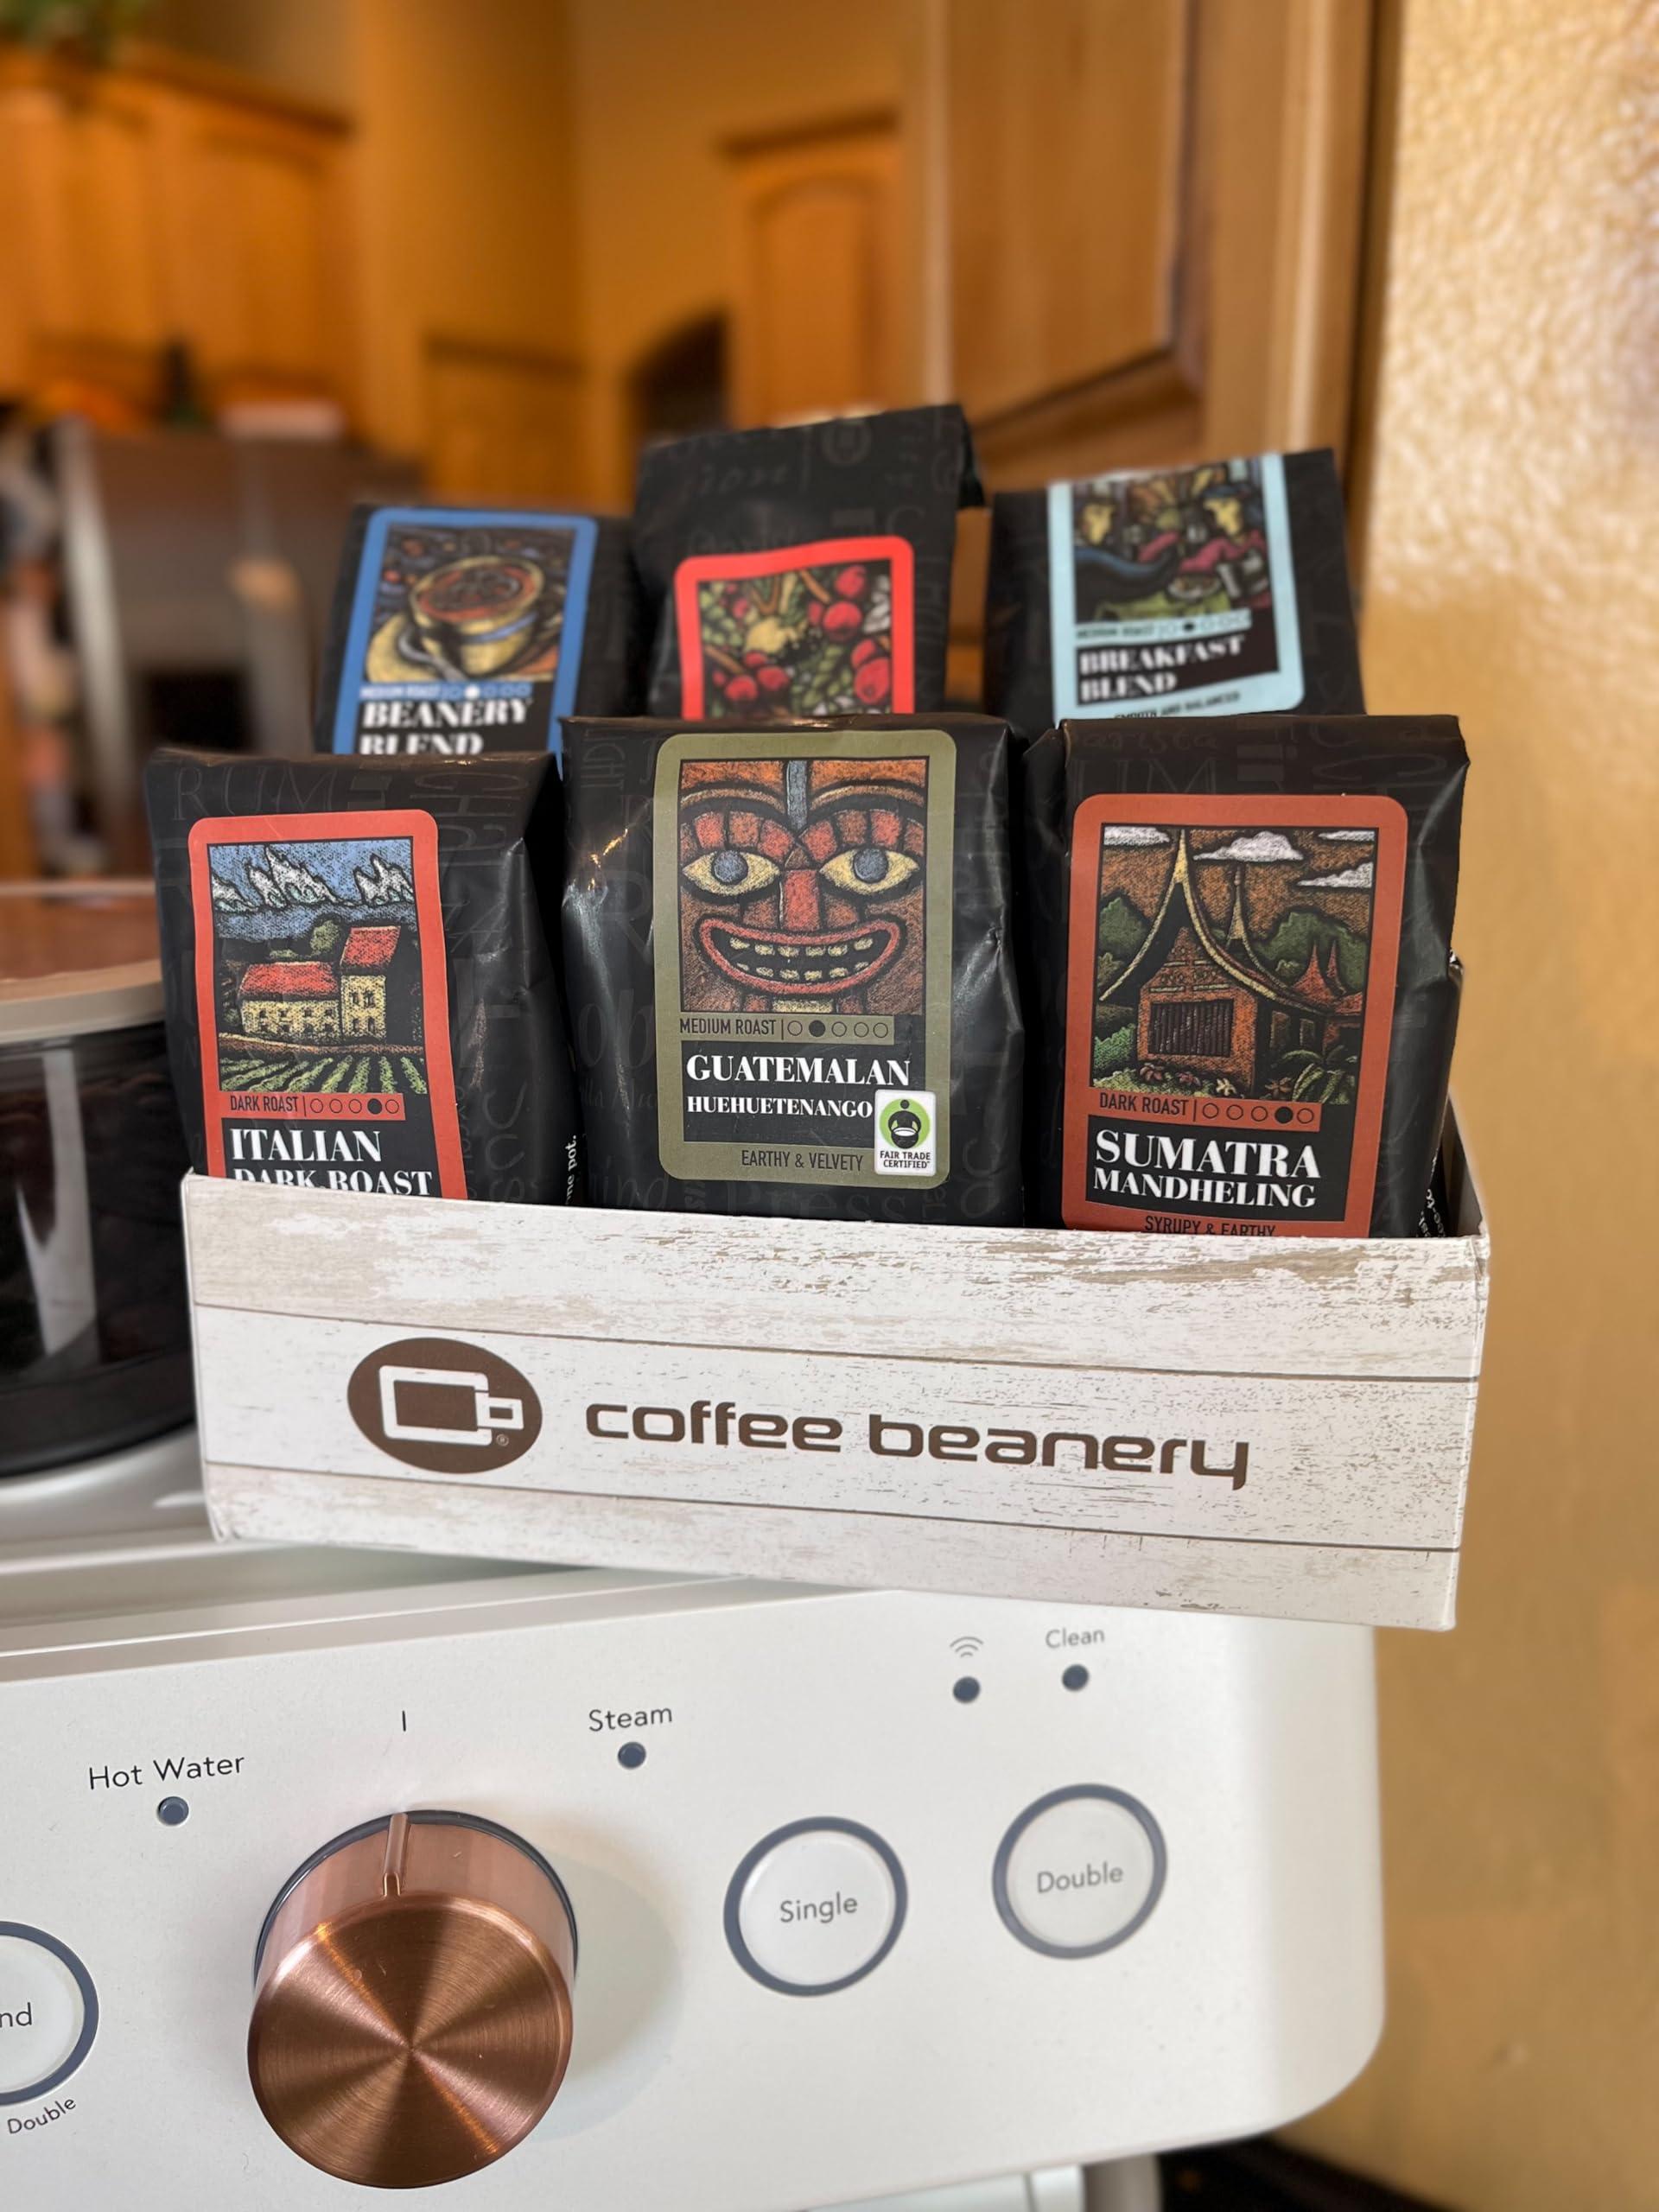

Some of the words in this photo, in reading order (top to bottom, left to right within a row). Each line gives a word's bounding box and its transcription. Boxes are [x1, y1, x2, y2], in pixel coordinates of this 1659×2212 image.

[1080, 635, 1245, 674] BREAKFAST
[1080, 672, 1177, 702] BLEND
[363, 698, 532, 728] BEANERY
[359, 732, 484, 755] BLEND
[679, 1018, 731, 1034] MEDIUM
[736, 1020, 776, 1035] ROAST
[686, 1054, 911, 1085] GUATEMALAN
[230, 1096, 260, 1111] DARK
[264, 1096, 299, 1112] ROAST
[687, 1096, 873, 1118] HUEHUETENANGO
[1099, 1092, 1137, 1113] DARK
[1142, 1096, 1189, 1116] ROAST
[230, 1128, 382, 1161] ITALIAN
[564, 1135, 578, 1172] pot.
[880, 1150, 899, 1160] FAIR
[902, 1151, 931, 1160] TRADE
[1096, 1129, 1321, 1179] SUMATRA
[741, 1149, 791, 1168] EARTHY
[795, 1154, 804, 1168] &
[809, 1153, 863, 1171] VELVETY
[327, 1170, 432, 1195] ROAST
[1093, 1166, 1316, 1208] MANDHELING
[1145, 1216, 1201, 1235] SYRUPY
[1205, 1224, 1216, 1235] &
[1221, 1223, 1276, 1236] EARTHY
[586, 1400, 843, 1452] coffee
[868, 1414, 1249, 1491] beanery
[1045, 1626, 1106, 1649] Clean
[588, 1703, 674, 1733] Steam
[88, 1764, 143, 1791] Hot
[153, 1752, 245, 1783] Water
[1037, 1861, 1124, 1894] Double
[779, 1892, 859, 1927] Single
[7, 2098, 77, 2135] Double
